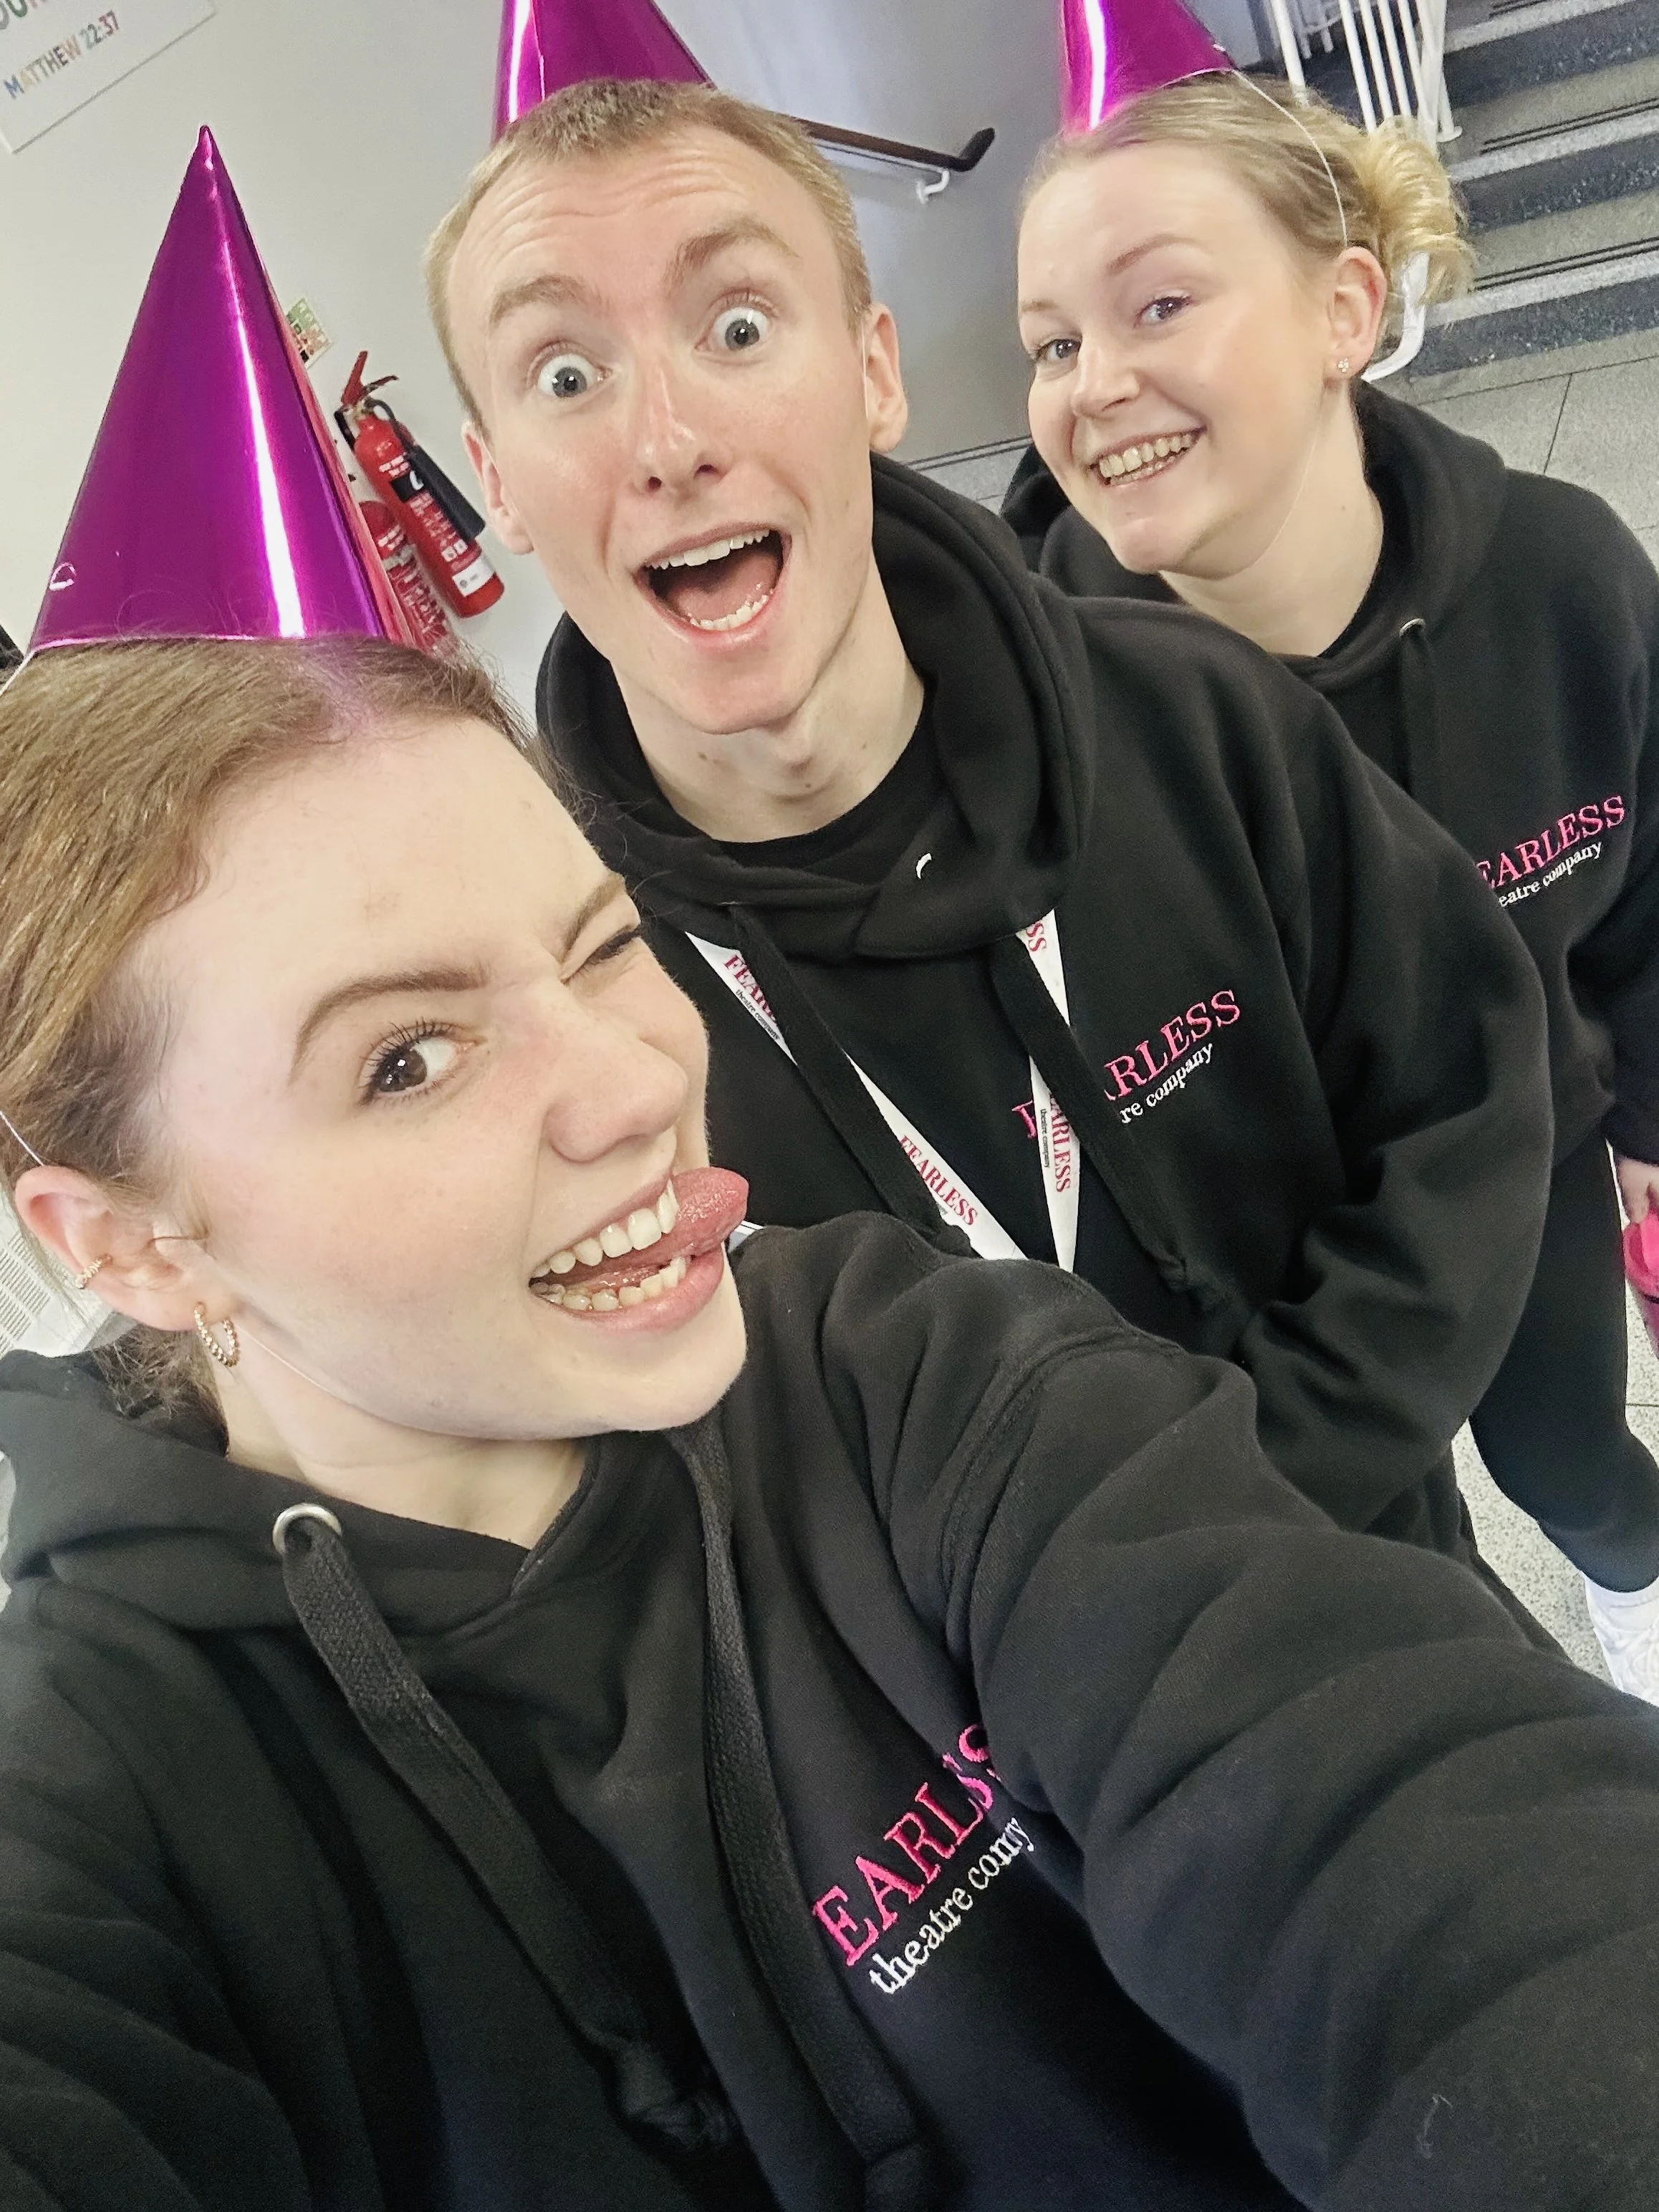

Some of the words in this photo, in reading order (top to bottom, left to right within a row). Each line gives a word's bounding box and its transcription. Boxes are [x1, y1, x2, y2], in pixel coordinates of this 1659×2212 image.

[4, 34, 82, 99] MATTHEW
[79, 10, 120, 49] 22:37
[1542, 841, 1602, 888] company
[1145, 1042, 1213, 1108] company
[869, 1888, 973, 1994] theatre
